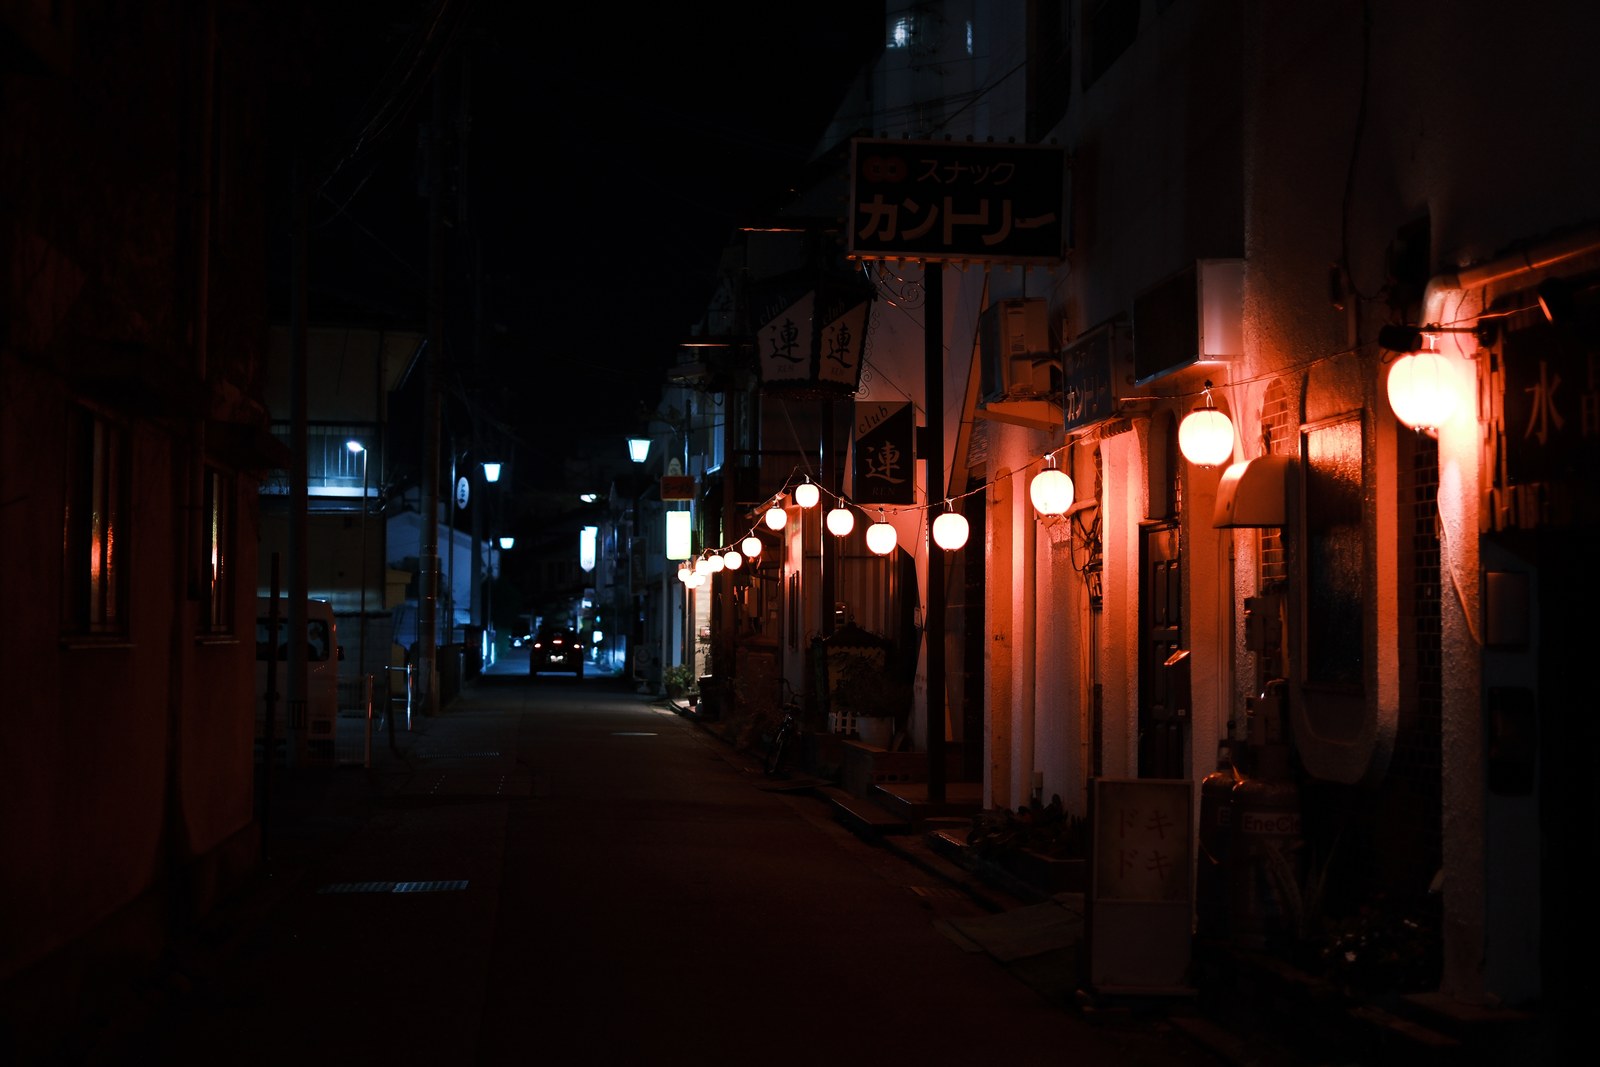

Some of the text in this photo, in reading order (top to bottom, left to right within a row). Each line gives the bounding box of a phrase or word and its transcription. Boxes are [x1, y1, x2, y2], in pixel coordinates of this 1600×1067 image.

[916, 159, 1017, 186] スナック
[857, 194, 1057, 246] カントリー
[770, 318, 804, 363] 連
[826, 321, 853, 368] 連
[858, 405, 890, 434] club
[864, 440, 907, 485] 連
[1119, 807, 1175, 841] ドキ
[1119, 849, 1174, 881] ドキ
